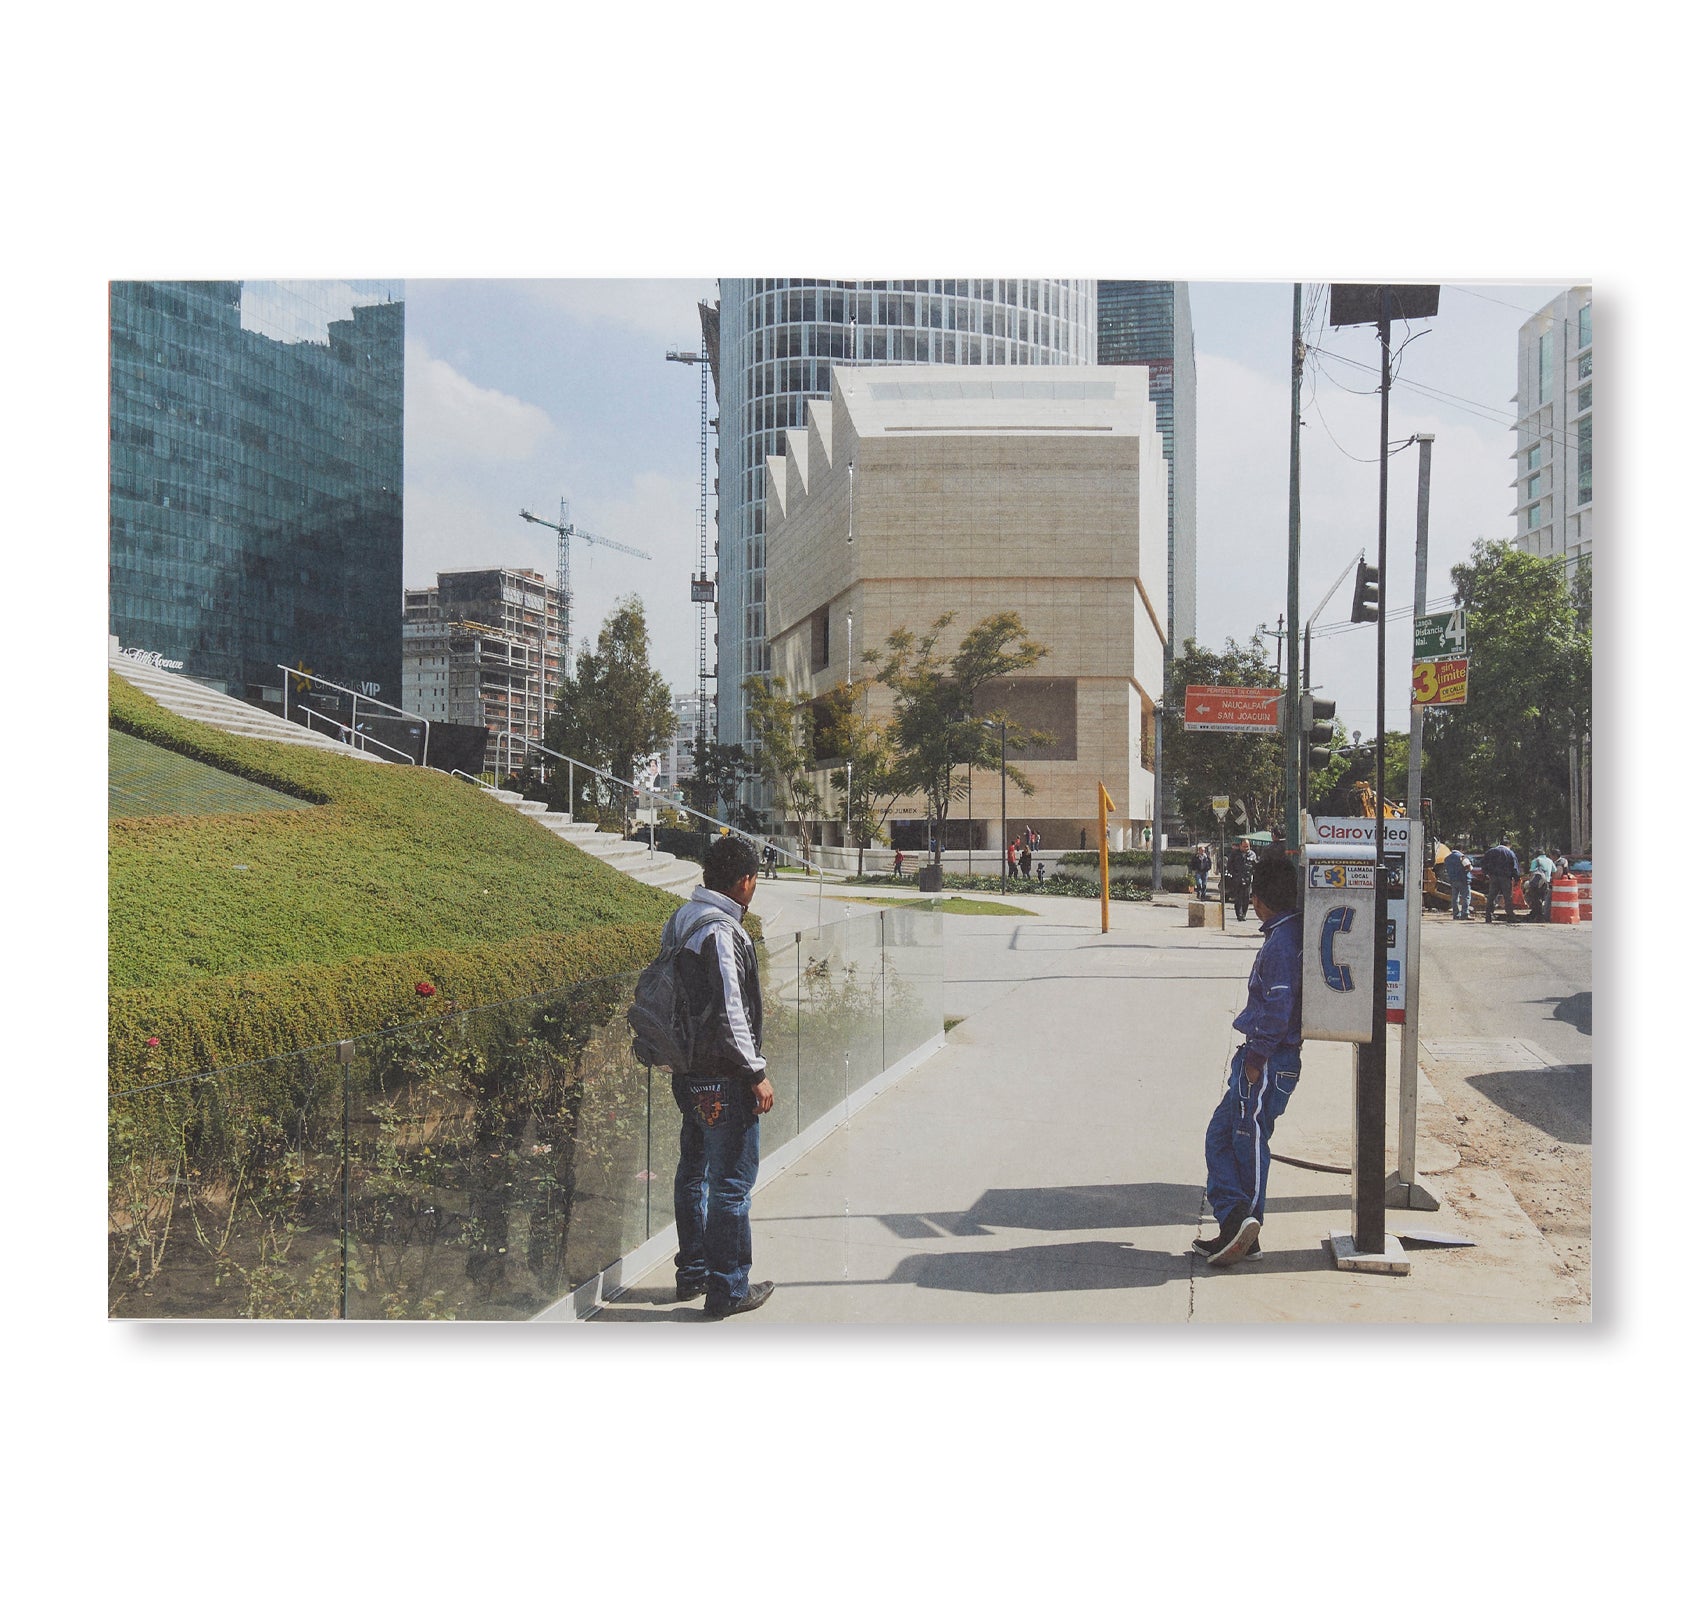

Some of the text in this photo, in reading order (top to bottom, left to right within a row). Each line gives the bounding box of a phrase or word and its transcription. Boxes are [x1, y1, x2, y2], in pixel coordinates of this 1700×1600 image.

[1415, 626, 1444, 637] Distancia
[1440, 663, 1454, 673] sin
[361, 681, 381, 696] VIP
[1222, 700, 1267, 710] NAUCALPAN
[1217, 711, 1270, 721] SAN JOAQUIN
